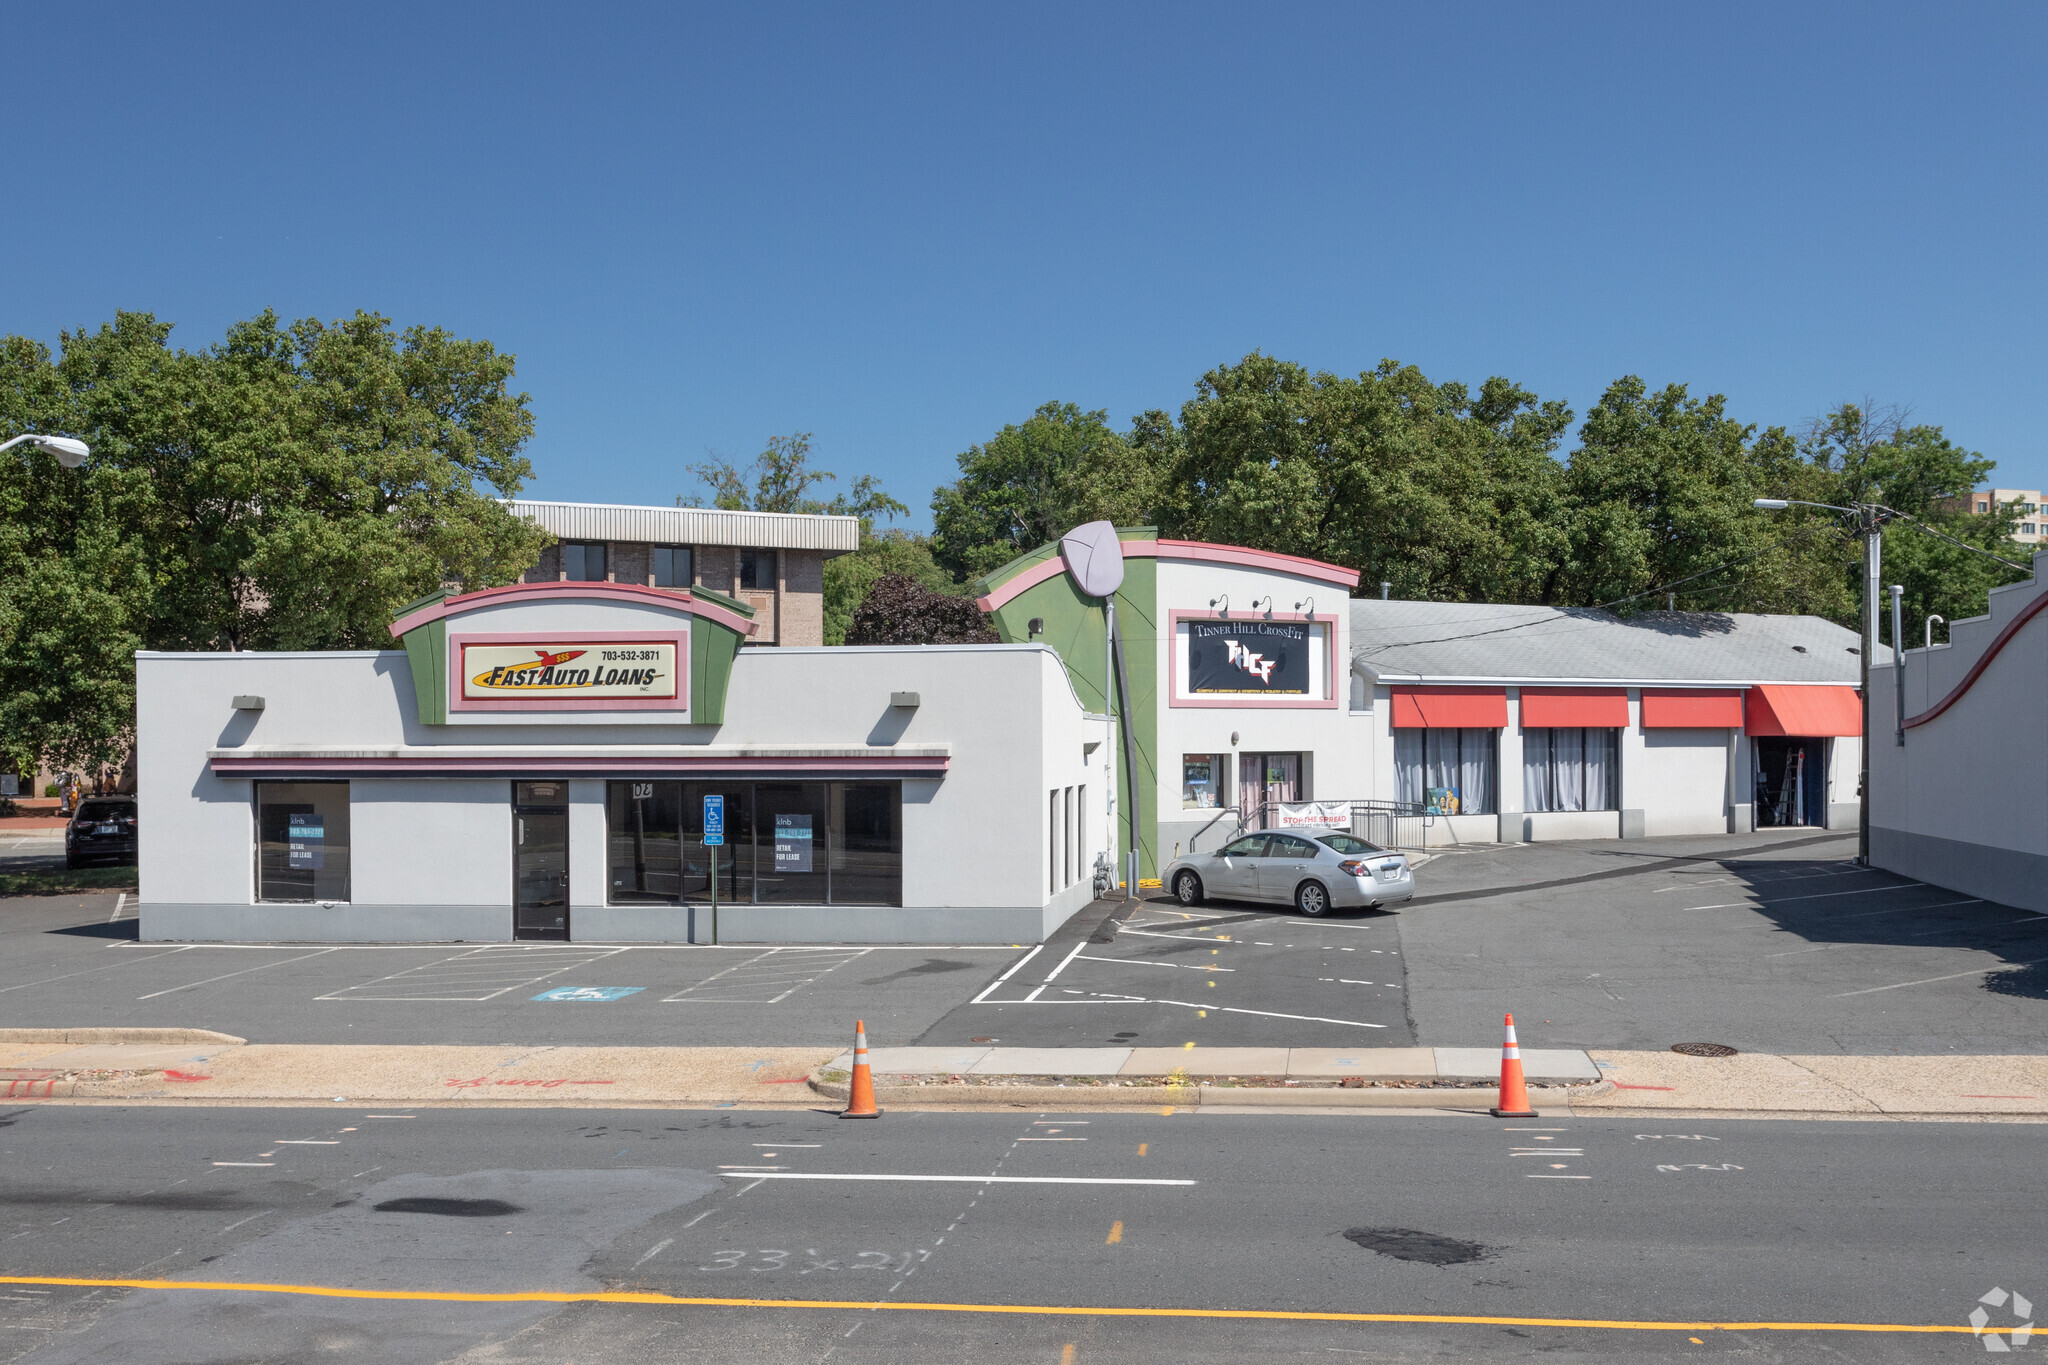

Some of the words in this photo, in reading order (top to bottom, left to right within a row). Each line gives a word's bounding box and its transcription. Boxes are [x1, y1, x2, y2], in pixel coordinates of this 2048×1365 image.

[1194, 624, 1231, 637] TINNER
[1233, 622, 1257, 634] HILL
[602, 650, 660, 660] 703-532-3871
[488, 666, 539, 686] FAST
[538, 665, 590, 686] AUTO
[592, 665, 656, 686] LOANS
[1283, 816, 1303, 824] STOP
[1304, 815, 1317, 823] THE
[1319, 815, 1347, 823] SPREAD
